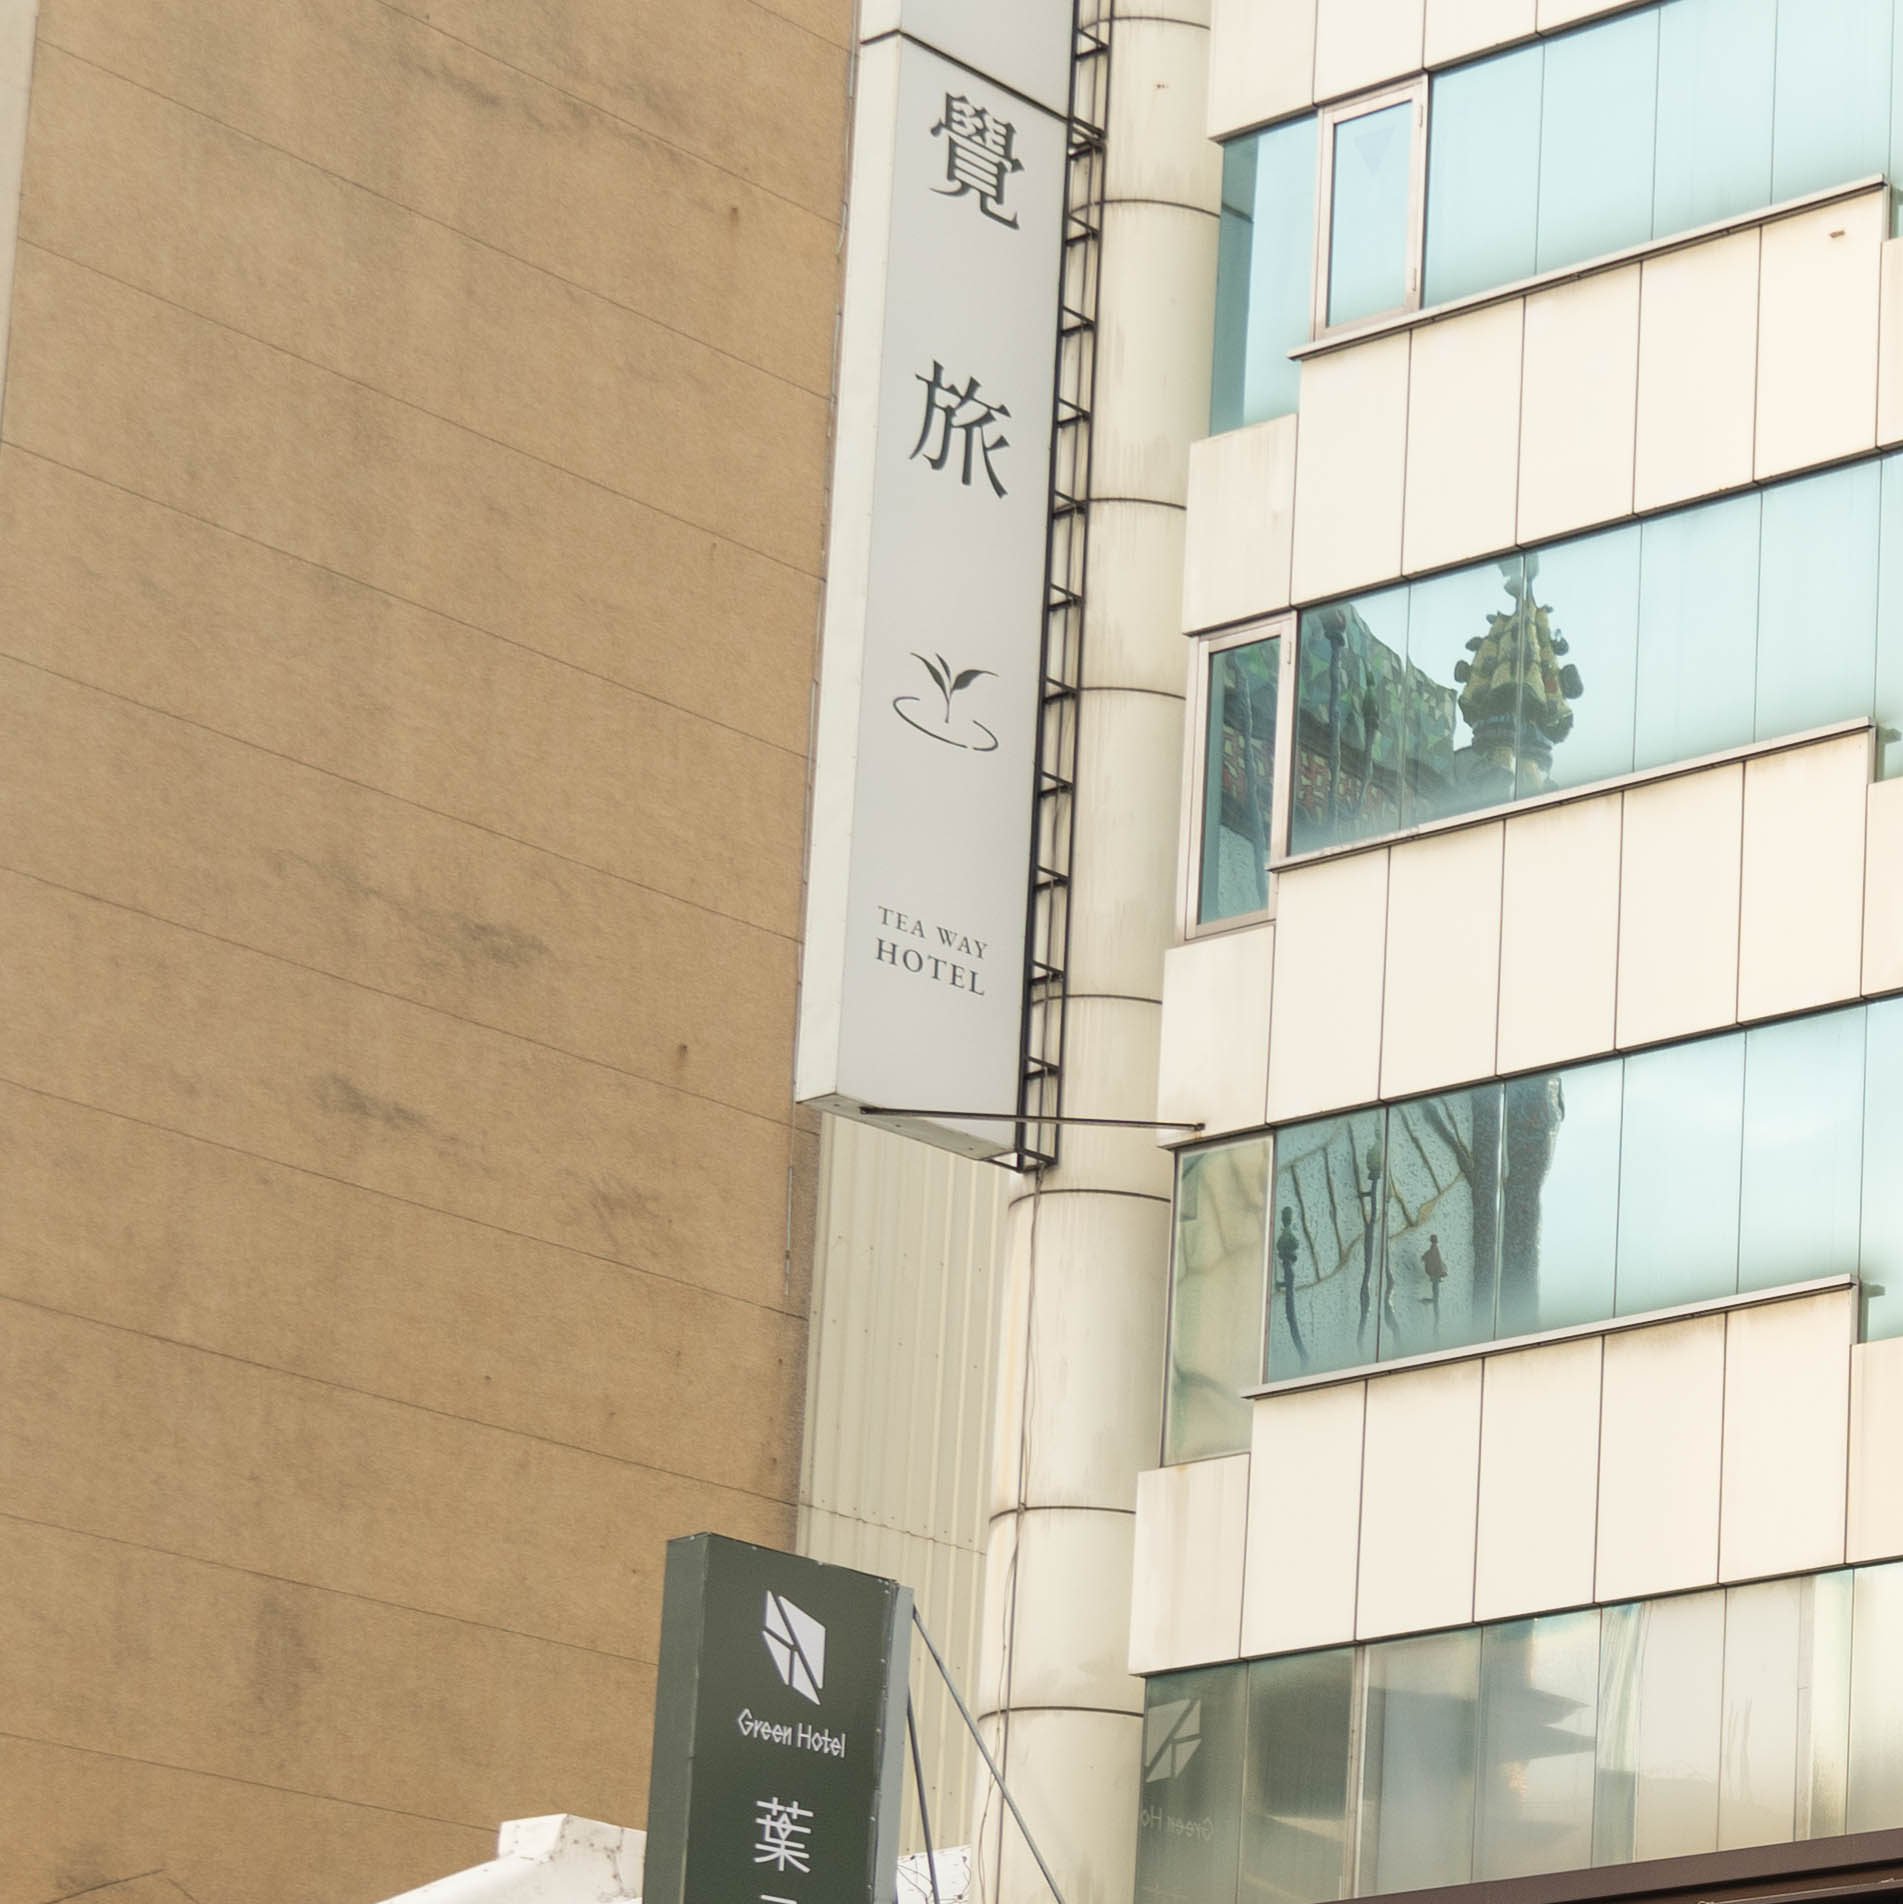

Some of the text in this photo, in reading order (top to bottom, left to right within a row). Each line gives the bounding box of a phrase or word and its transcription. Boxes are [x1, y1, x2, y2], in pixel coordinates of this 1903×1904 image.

[878, 905, 988, 960] TEA WAY
[875, 937, 985, 997] HOTEL
[738, 1706, 847, 1758] Green Hotel
